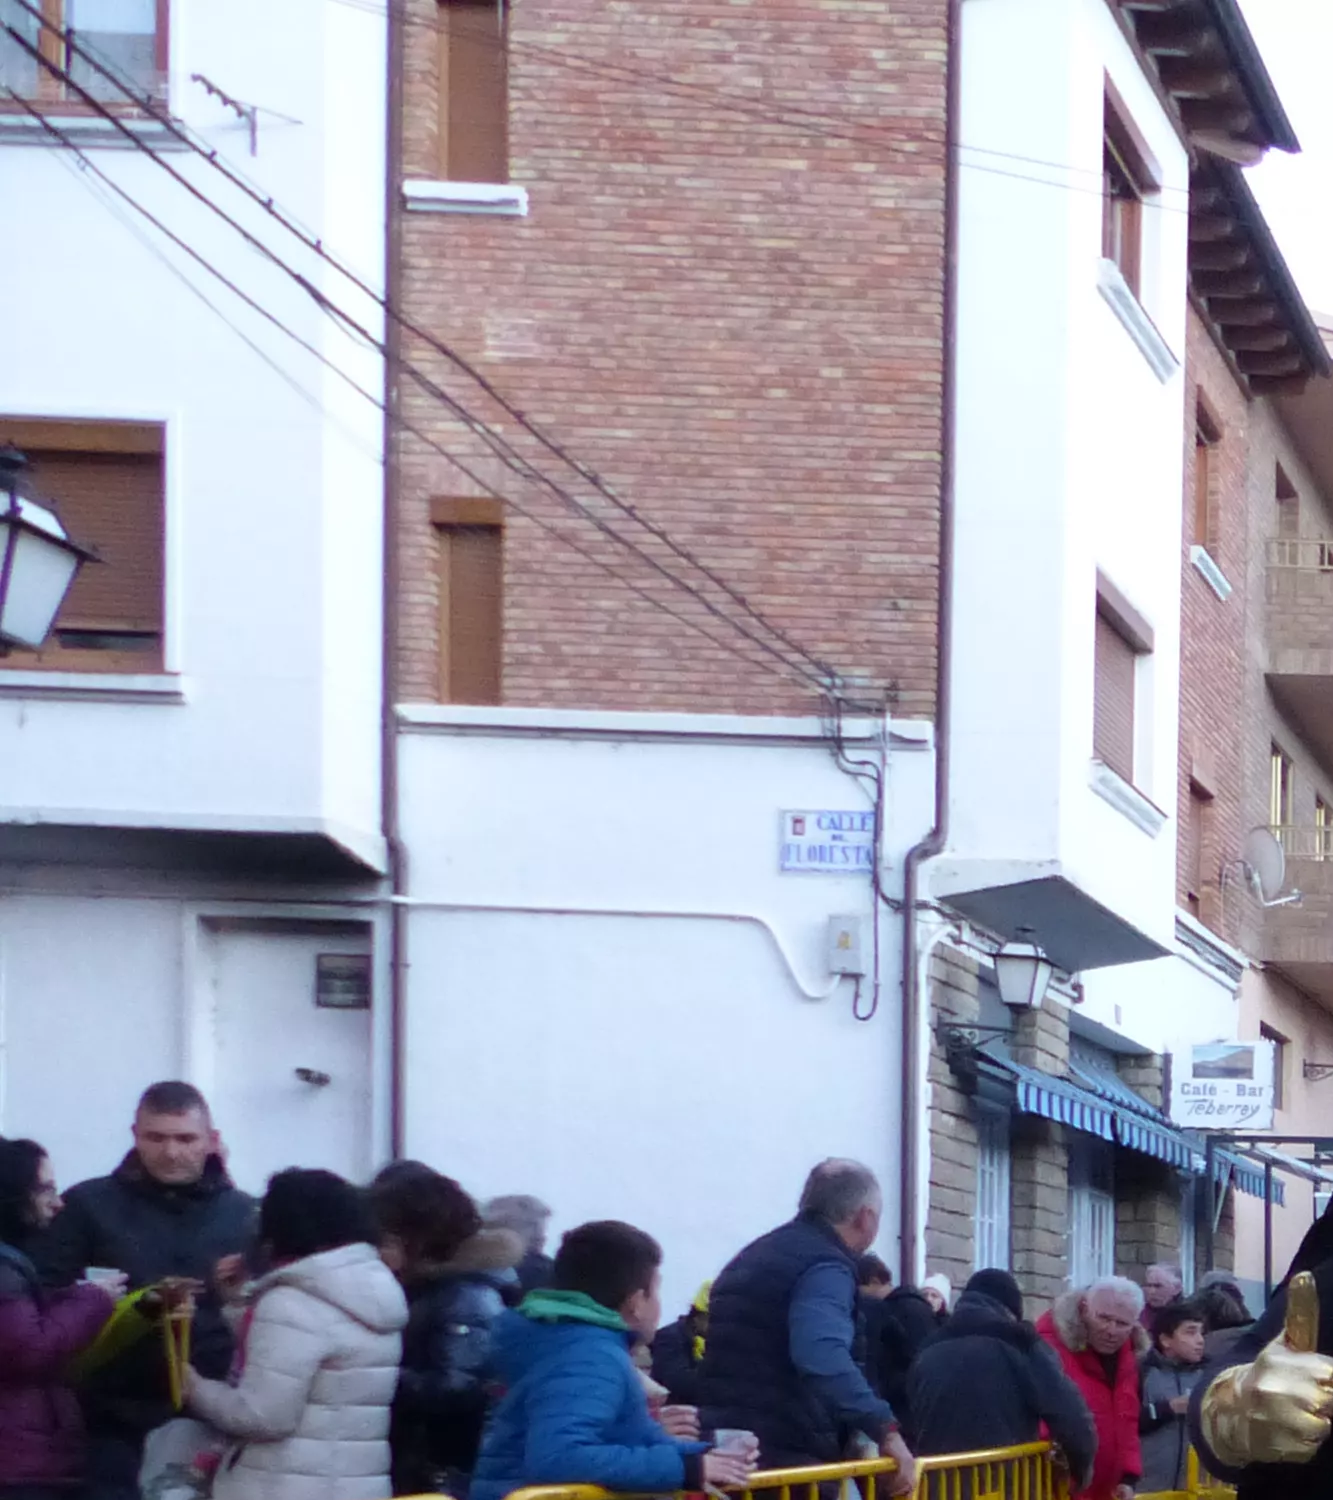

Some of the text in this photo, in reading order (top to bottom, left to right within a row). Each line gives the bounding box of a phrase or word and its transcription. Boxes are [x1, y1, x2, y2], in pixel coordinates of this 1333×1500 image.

[816, 813, 872, 832] CALLE
[1180, 1083, 1217, 1097] Café
[1236, 1084, 1264, 1097] Bar
